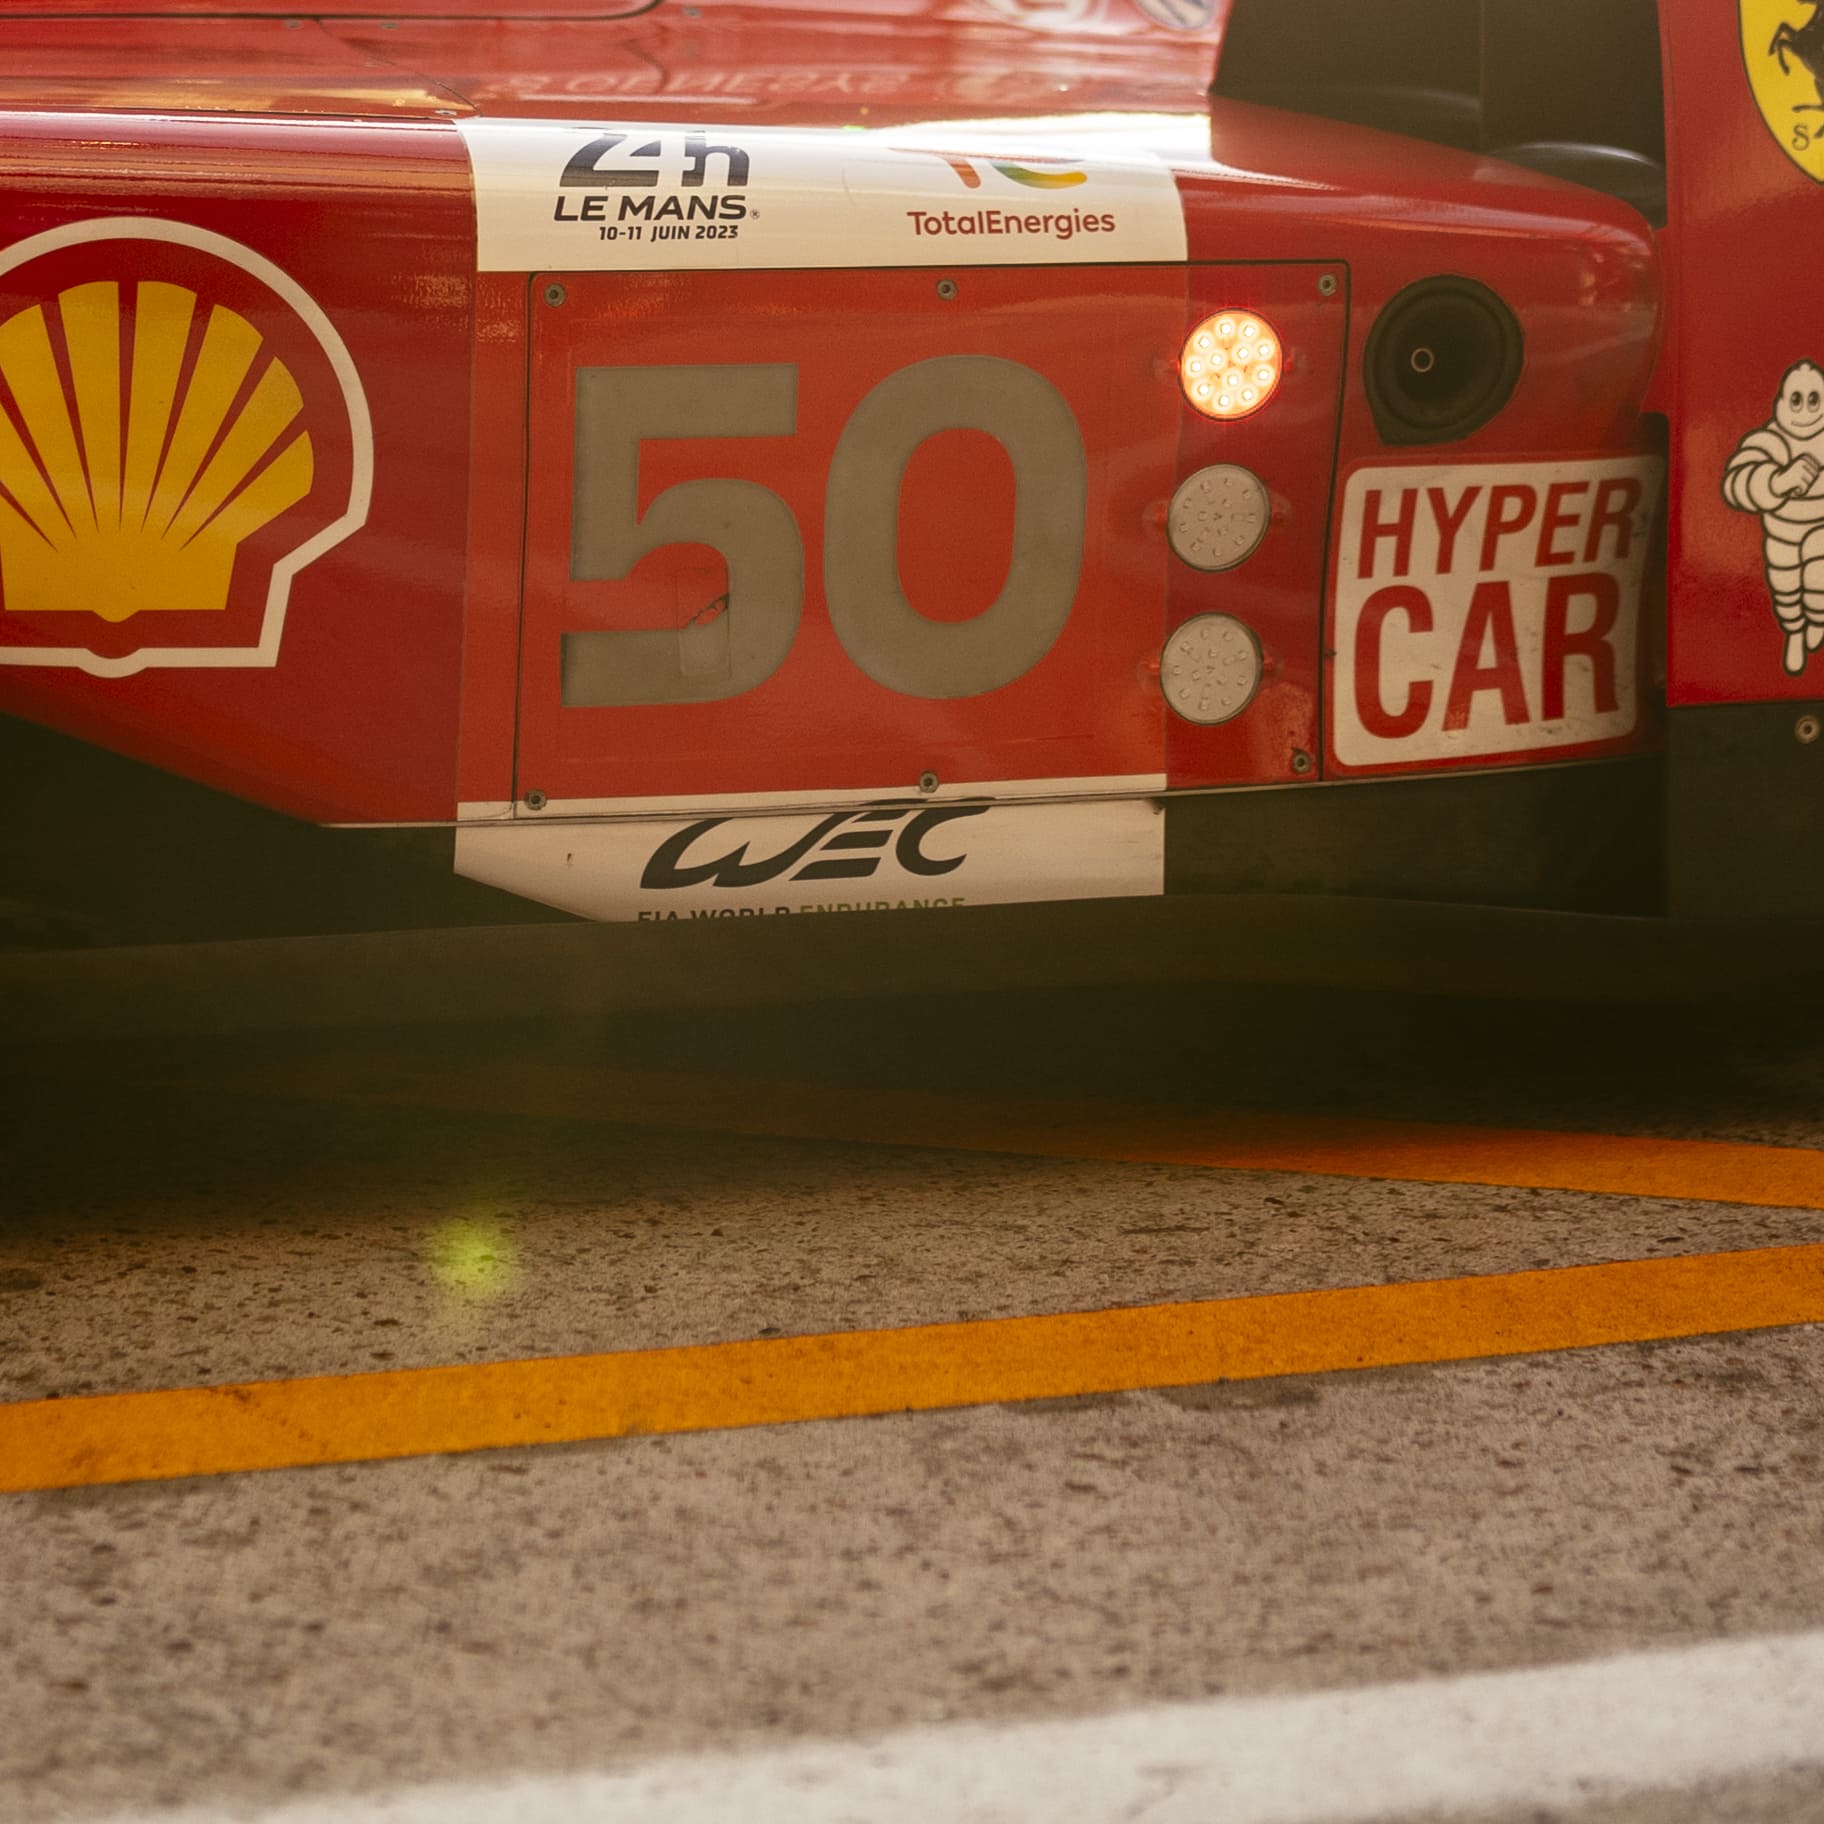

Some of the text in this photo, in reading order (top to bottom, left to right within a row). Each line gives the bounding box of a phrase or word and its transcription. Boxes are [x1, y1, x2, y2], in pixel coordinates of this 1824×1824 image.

[554, 195, 748, 222] LE MANS
[600, 225, 739, 242] 10-11 JUIN 2023
[907, 208, 1117, 241] TotalEnergies
[560, 354, 1089, 709] 50
[1357, 478, 1643, 580] HYPER
[1354, 572, 1620, 740] CAR
[639, 798, 996, 890] WEC
